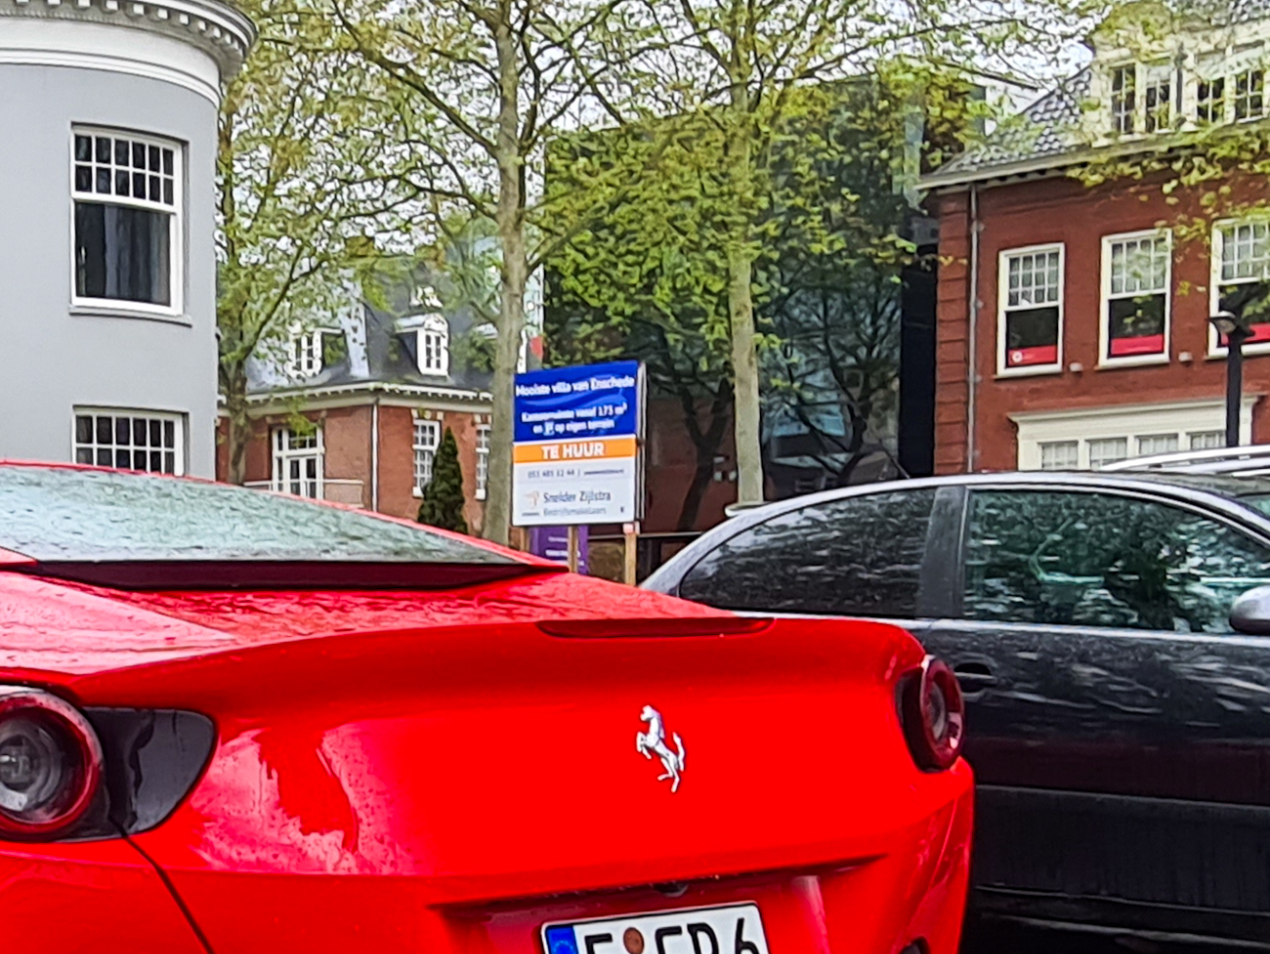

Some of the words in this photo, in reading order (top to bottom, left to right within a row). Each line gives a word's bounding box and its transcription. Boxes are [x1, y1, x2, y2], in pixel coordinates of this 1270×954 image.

[572, 380, 590, 391] van
[541, 444, 559, 460] TE
[562, 442, 605, 458] HUUR
